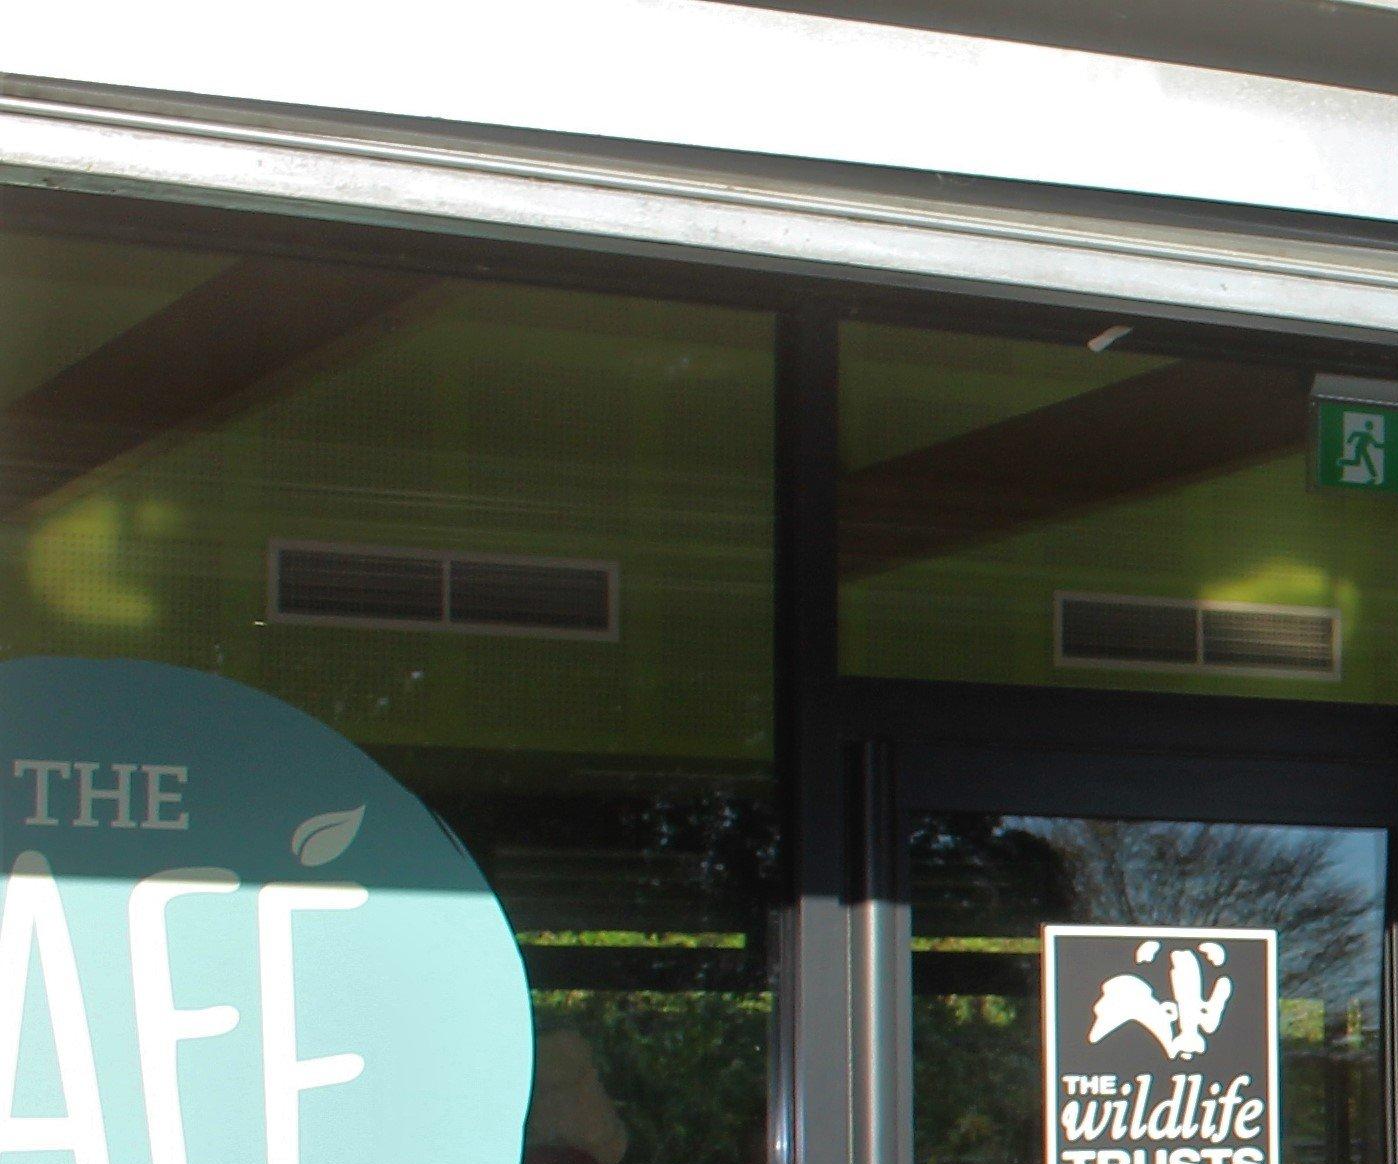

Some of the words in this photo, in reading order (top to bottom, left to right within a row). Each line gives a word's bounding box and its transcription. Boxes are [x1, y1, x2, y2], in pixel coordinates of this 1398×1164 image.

[14, 758, 190, 830] THE
[1061, 1073, 1264, 1144] wildlife
[1062, 1074, 1118, 1095] THE
